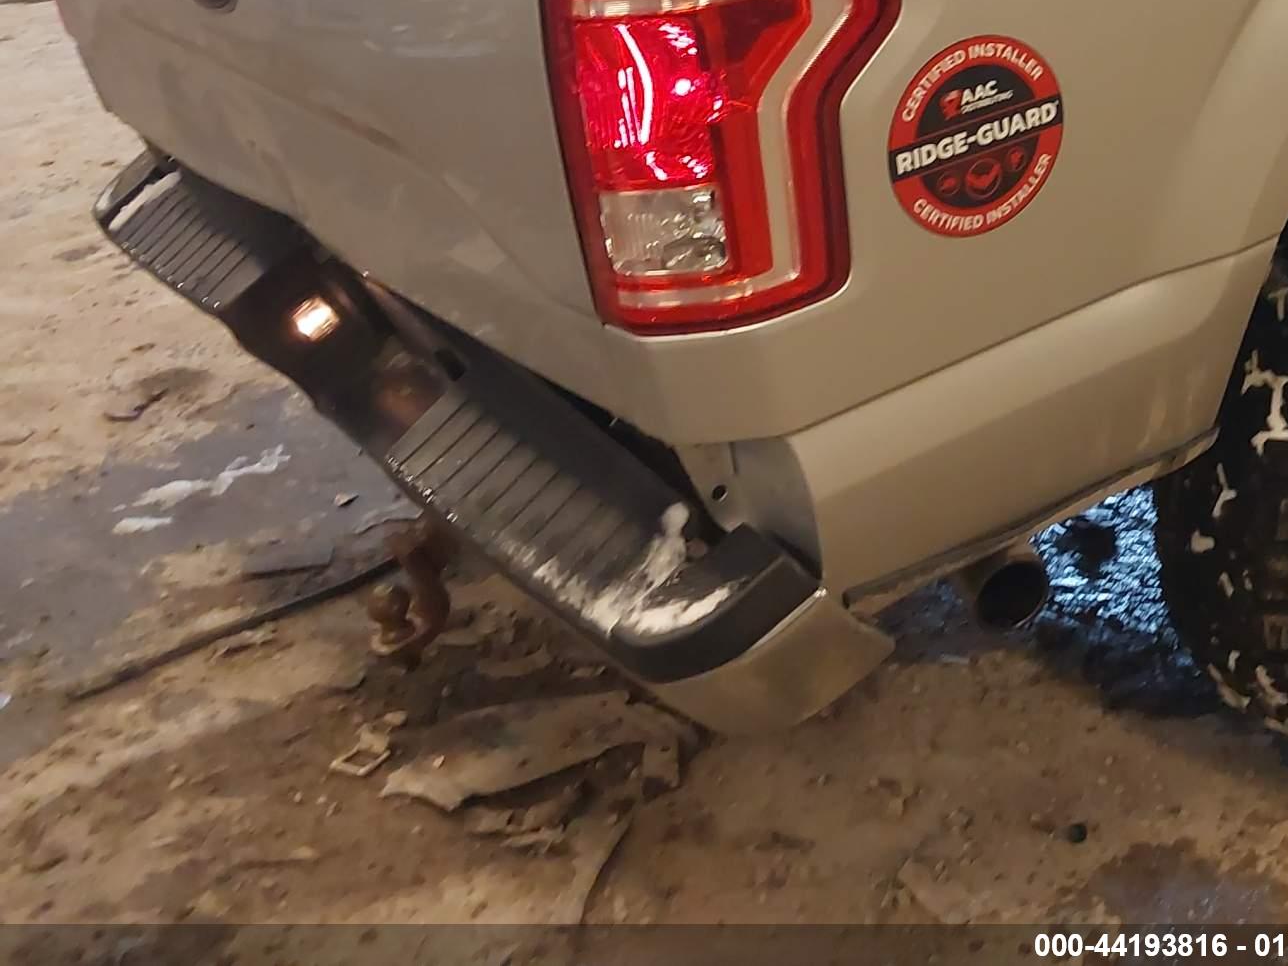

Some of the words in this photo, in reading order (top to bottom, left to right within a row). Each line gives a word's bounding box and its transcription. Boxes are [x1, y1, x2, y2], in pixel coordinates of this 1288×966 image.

[902, 49, 967, 123] CERTIFIED
[968, 42, 1044, 82] INSTALLER
[895, 101, 1059, 176] RIDGE-GUARD
[913, 198, 984, 231] CERTIFIED
[986, 153, 1052, 225] INSTALLER
